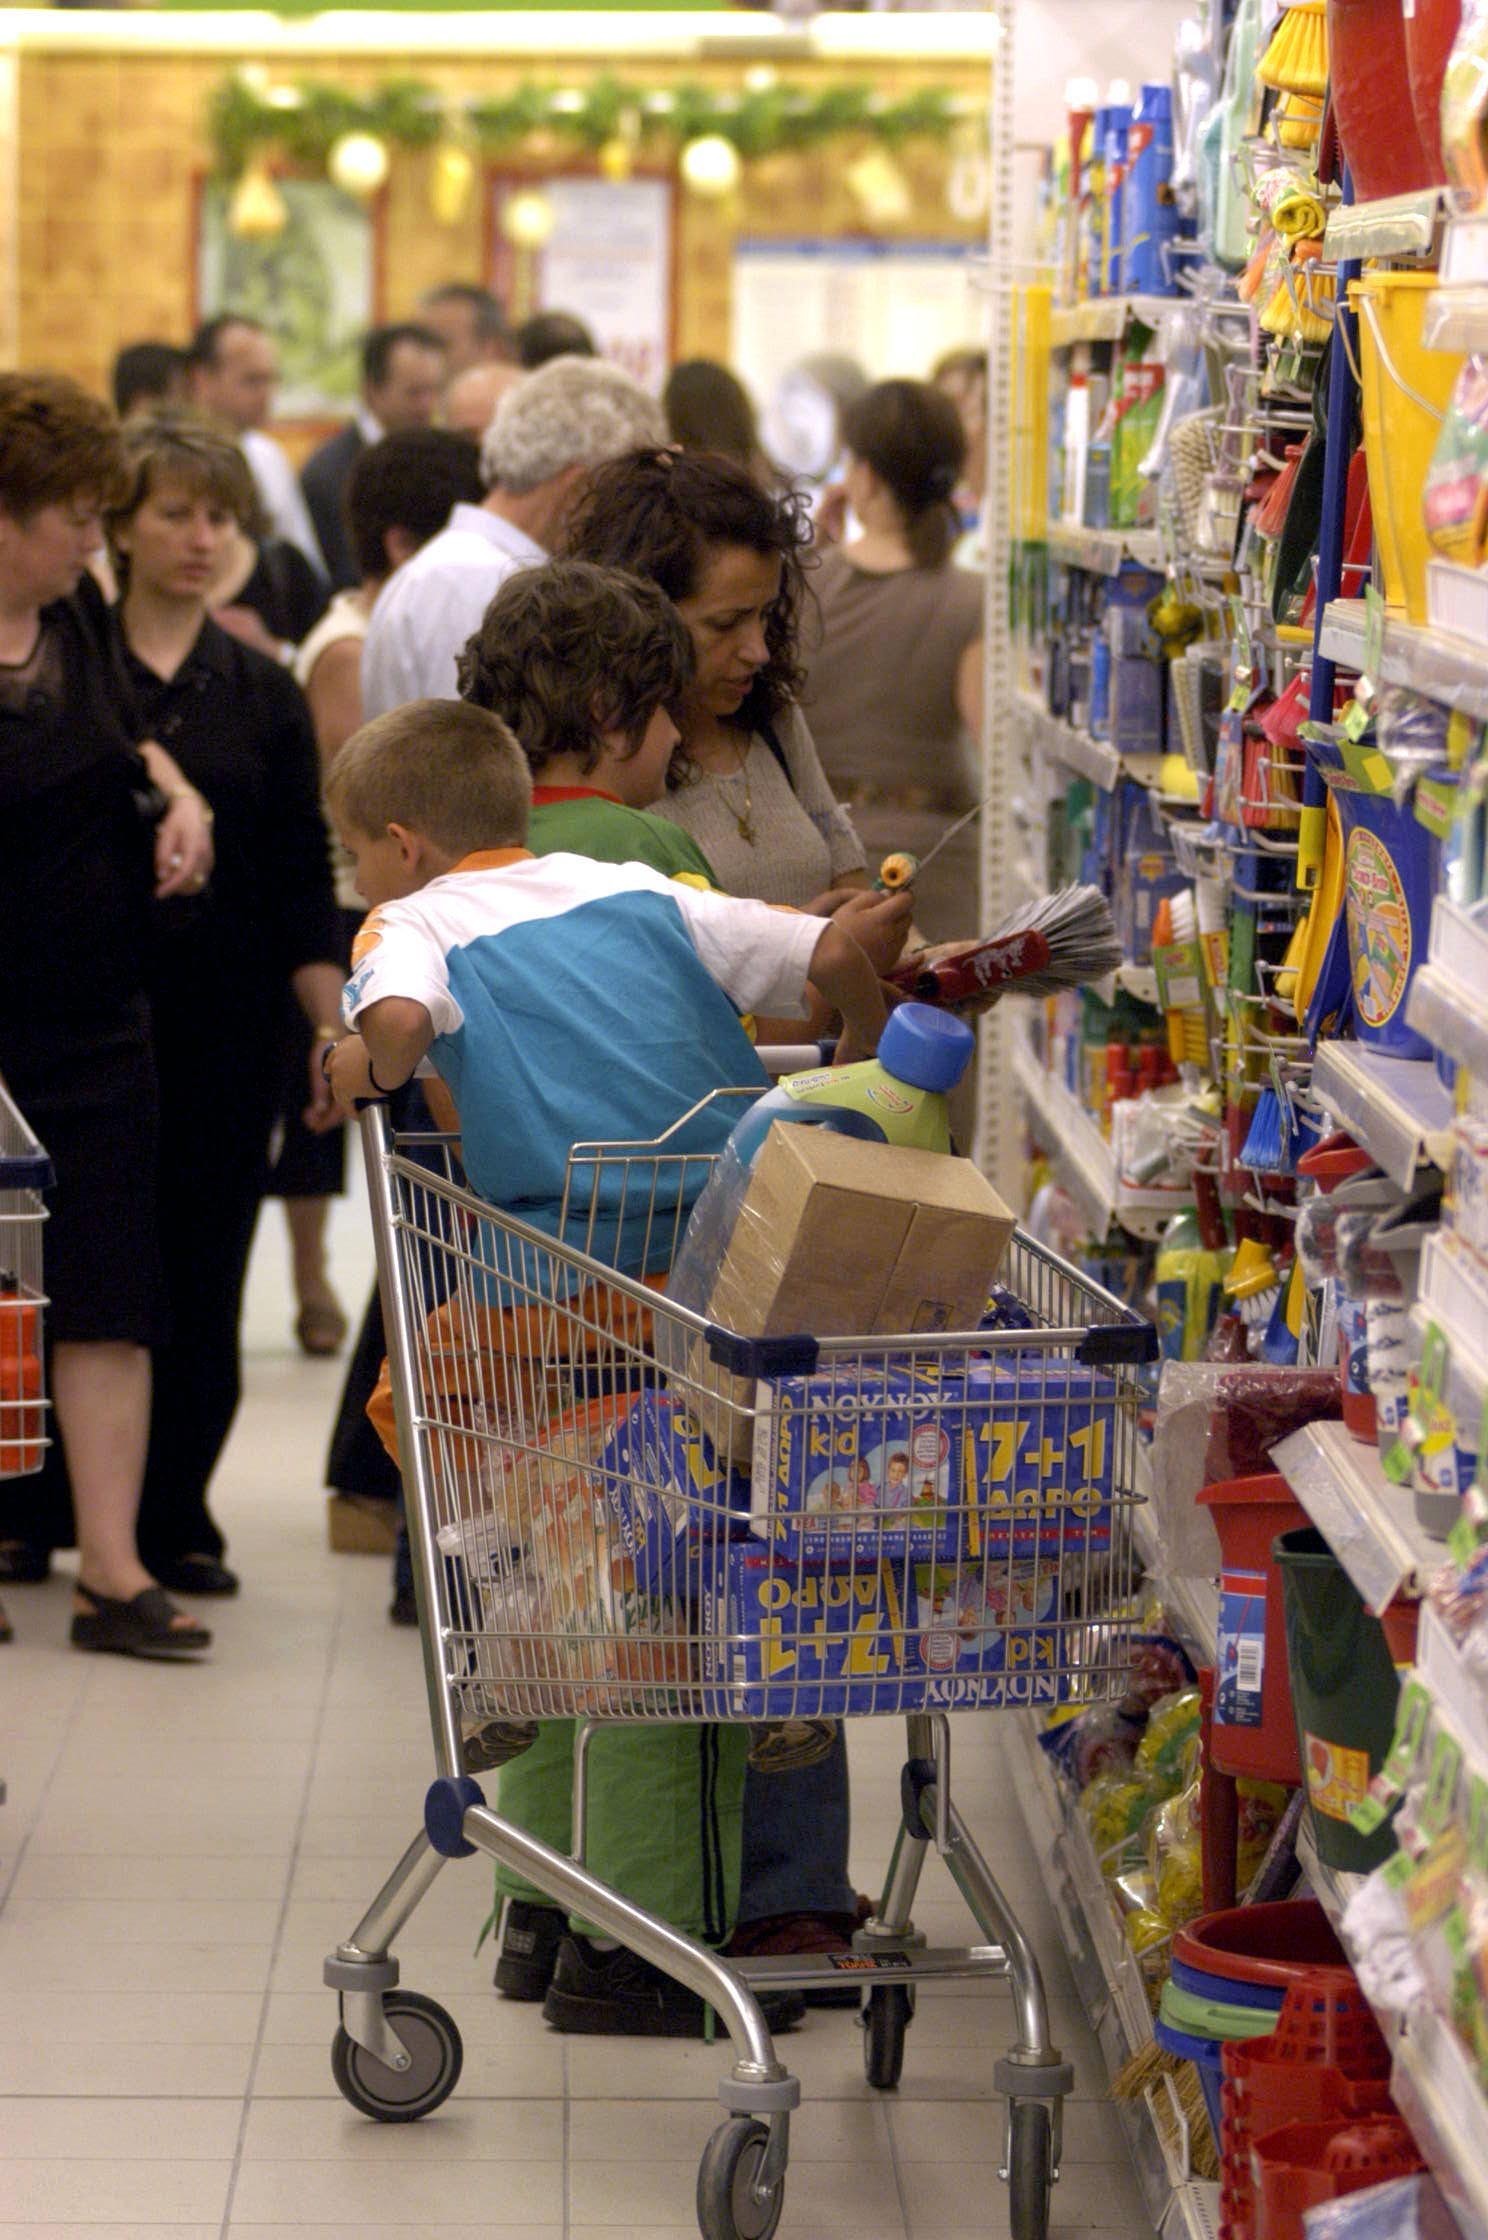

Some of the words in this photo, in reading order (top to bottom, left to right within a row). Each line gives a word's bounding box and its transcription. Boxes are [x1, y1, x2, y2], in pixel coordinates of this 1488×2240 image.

[810, 1424, 857, 1457] kid
[980, 1418, 1106, 1483] 7+1
[760, 1612, 890, 1680] 7+1
